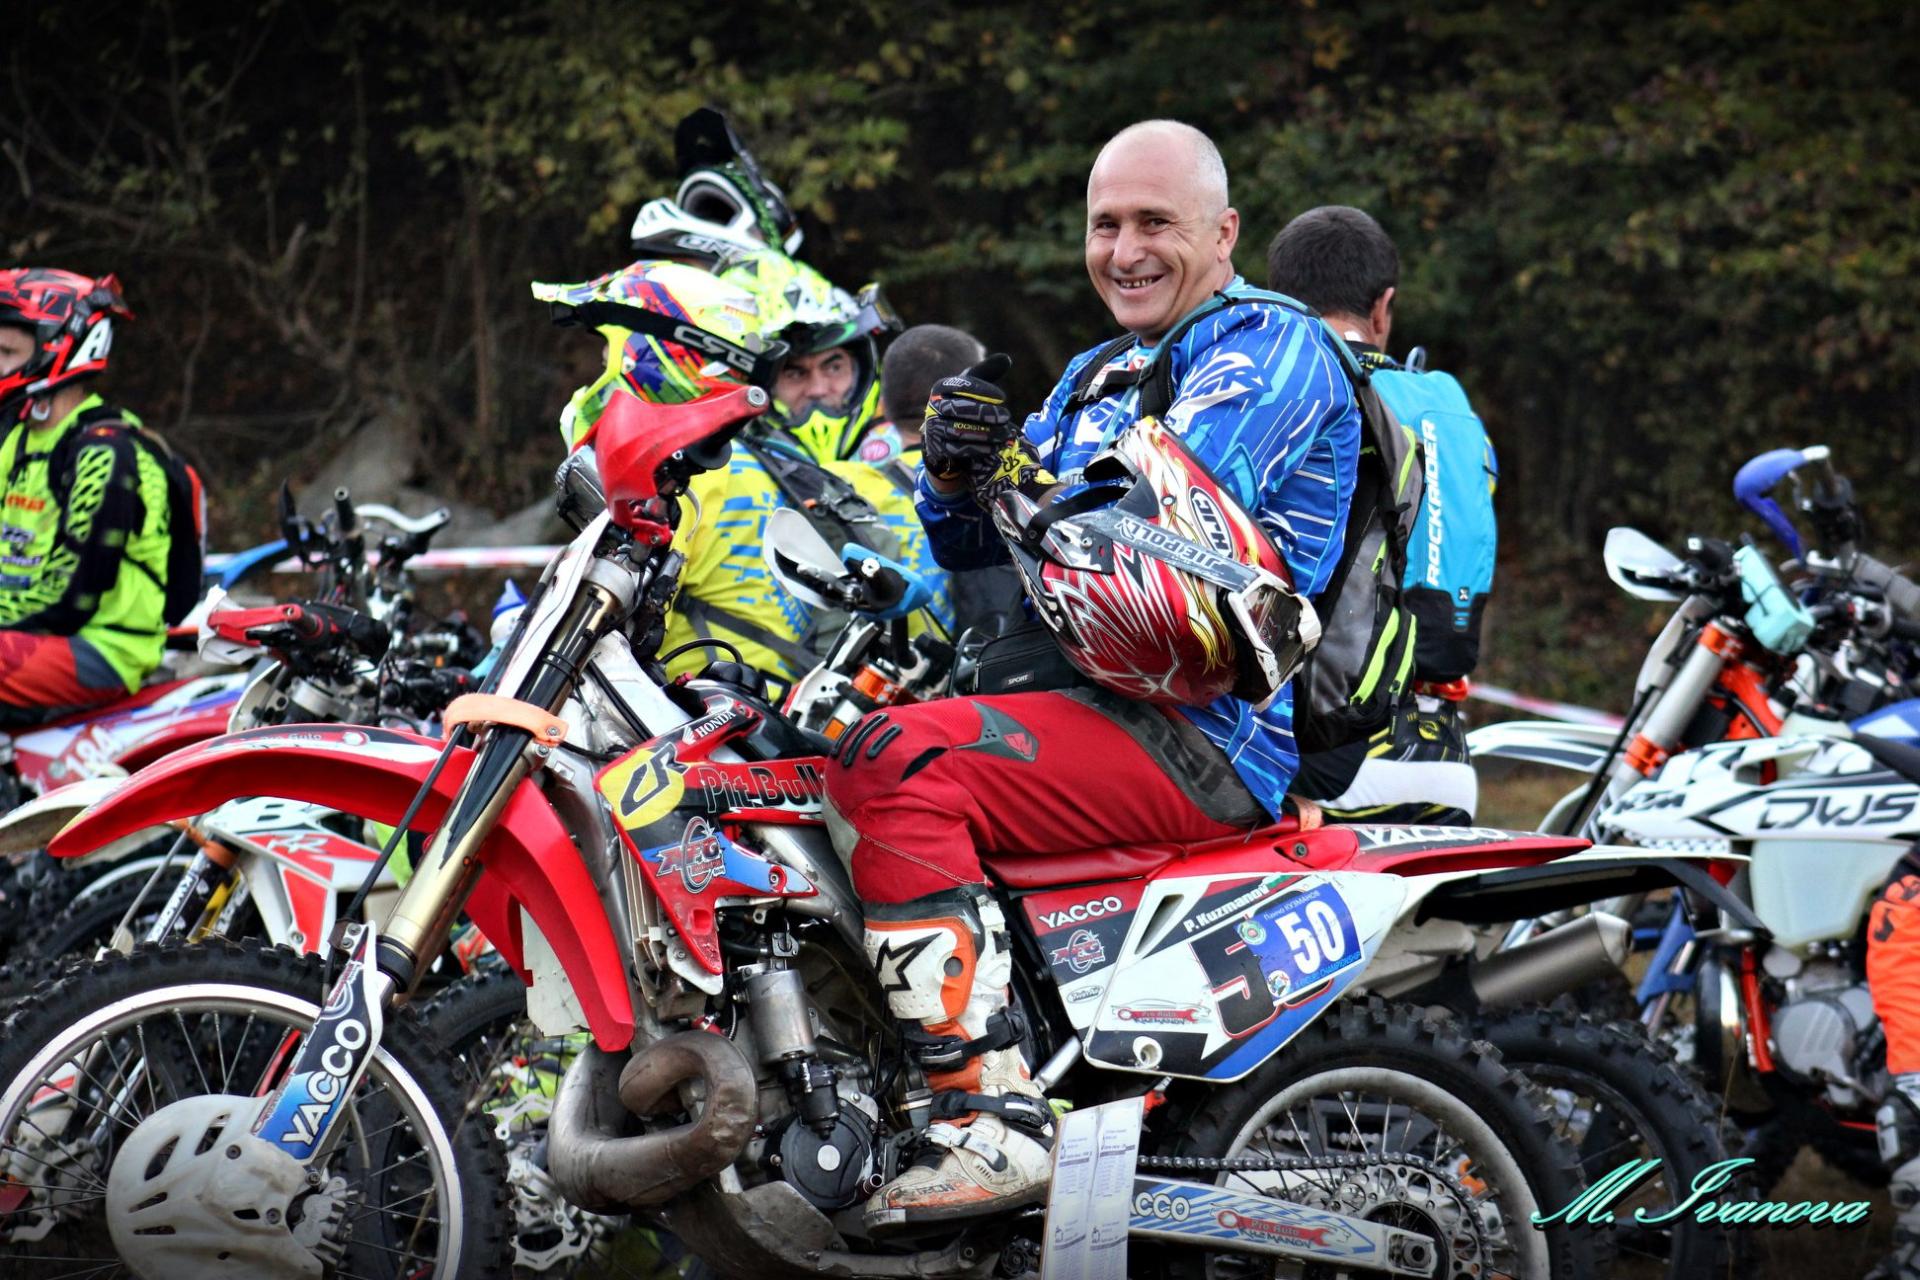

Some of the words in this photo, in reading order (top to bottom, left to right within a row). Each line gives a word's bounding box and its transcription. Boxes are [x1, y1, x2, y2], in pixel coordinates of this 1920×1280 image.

[1420, 418, 1445, 588] ROCKRIDER
[694, 710, 737, 738] HONDA
[1355, 825, 1509, 850] YACCO
[1038, 895, 1123, 930] YACCO
[1274, 900, 1346, 975] 50
[281, 1017, 367, 1147] YACCO
[1130, 1191, 1190, 1222] CCO
